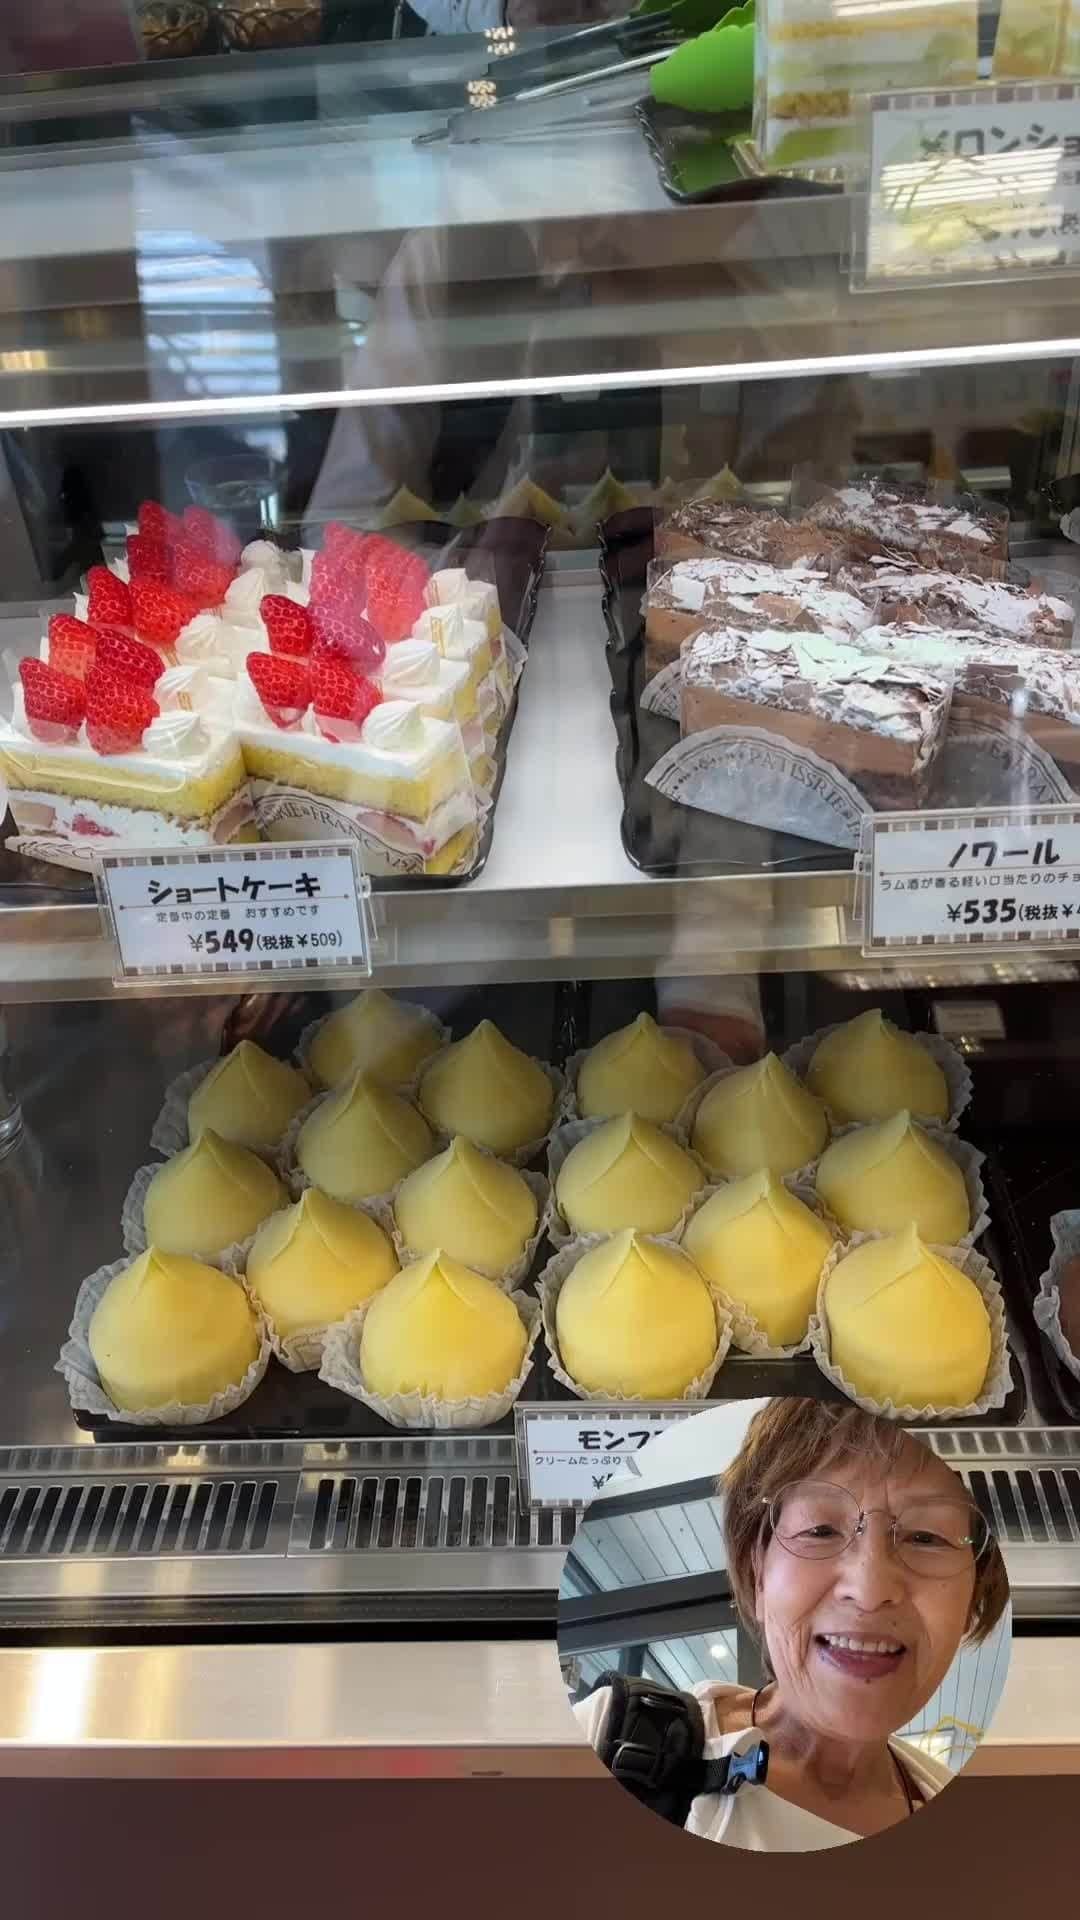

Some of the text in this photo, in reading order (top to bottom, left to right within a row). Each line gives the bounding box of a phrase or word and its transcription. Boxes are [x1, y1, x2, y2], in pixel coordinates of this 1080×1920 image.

[947, 838, 1060, 868] ノワール
[148, 873, 321, 905] ショートケーキ
[245, 904, 319, 919] おすすめです
[535, 1455, 622, 1466] クリームたっぷり
